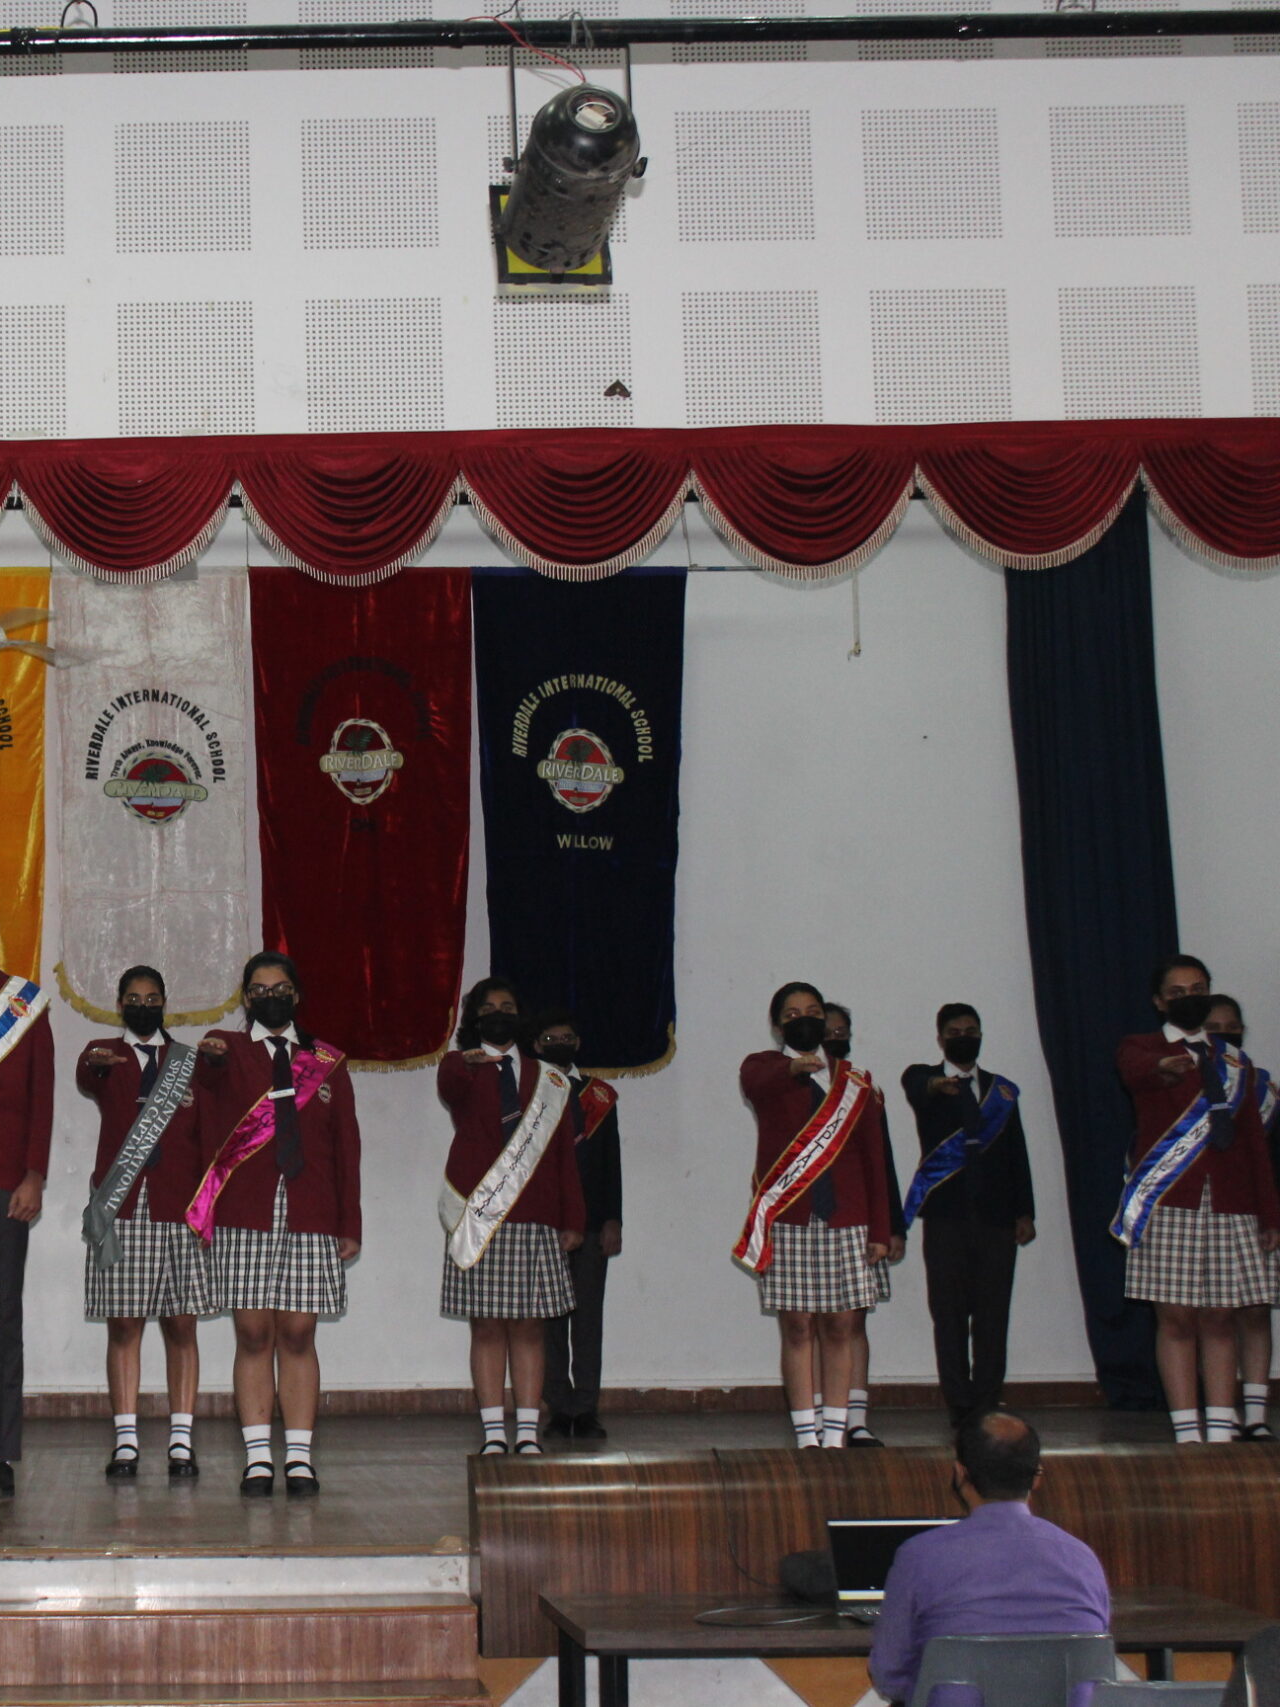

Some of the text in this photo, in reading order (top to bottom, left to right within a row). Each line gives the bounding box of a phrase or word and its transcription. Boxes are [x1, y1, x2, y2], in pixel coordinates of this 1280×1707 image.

[85, 689, 226, 784] RIVERDALE INTERNATIONAL SCHOOL
[145, 739, 184, 756] Knowledge
[512, 673, 653, 763] RIVERDALE INTERNATIONAL SCHOOL
[325, 753, 398, 770] RIVERDALE
[542, 760, 619, 782] RIVERDALE
[556, 834, 614, 850] WLLOW
[104, 1101, 177, 1212] INTERNATIONAL
[117, 1059, 182, 1169] SPORTS CAPTAIN
[777, 1106, 850, 1191] CAPTAIN
